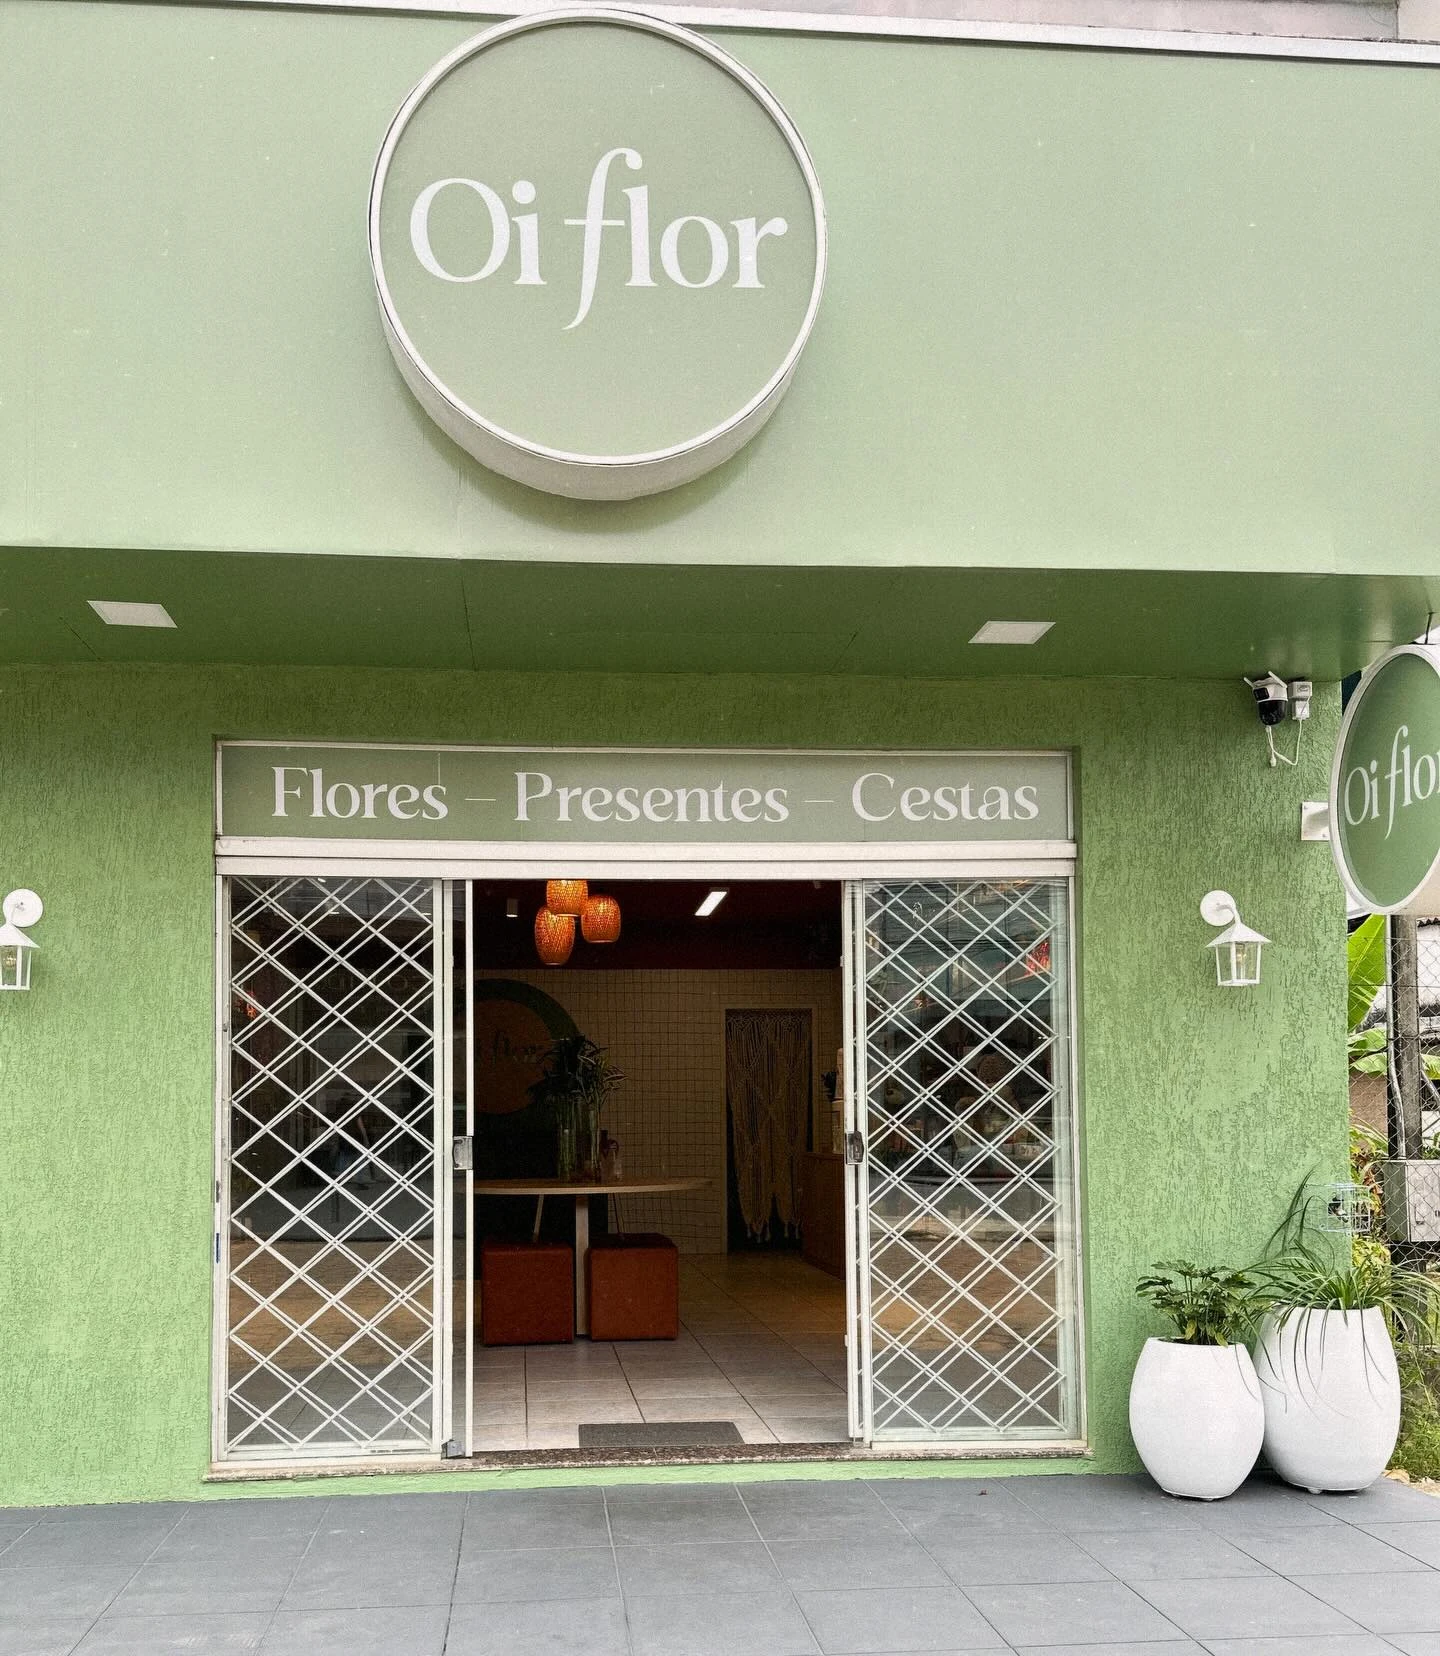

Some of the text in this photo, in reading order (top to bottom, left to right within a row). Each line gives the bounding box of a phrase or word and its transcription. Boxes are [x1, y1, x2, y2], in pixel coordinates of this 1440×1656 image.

[410, 147, 789, 330] Oi flor
[271, 766, 449, 820] Flores
[513, 771, 790, 823] Presentes
[851, 772, 1040, 822] Cestas
[1344, 724, 1440, 841] Oi flo
